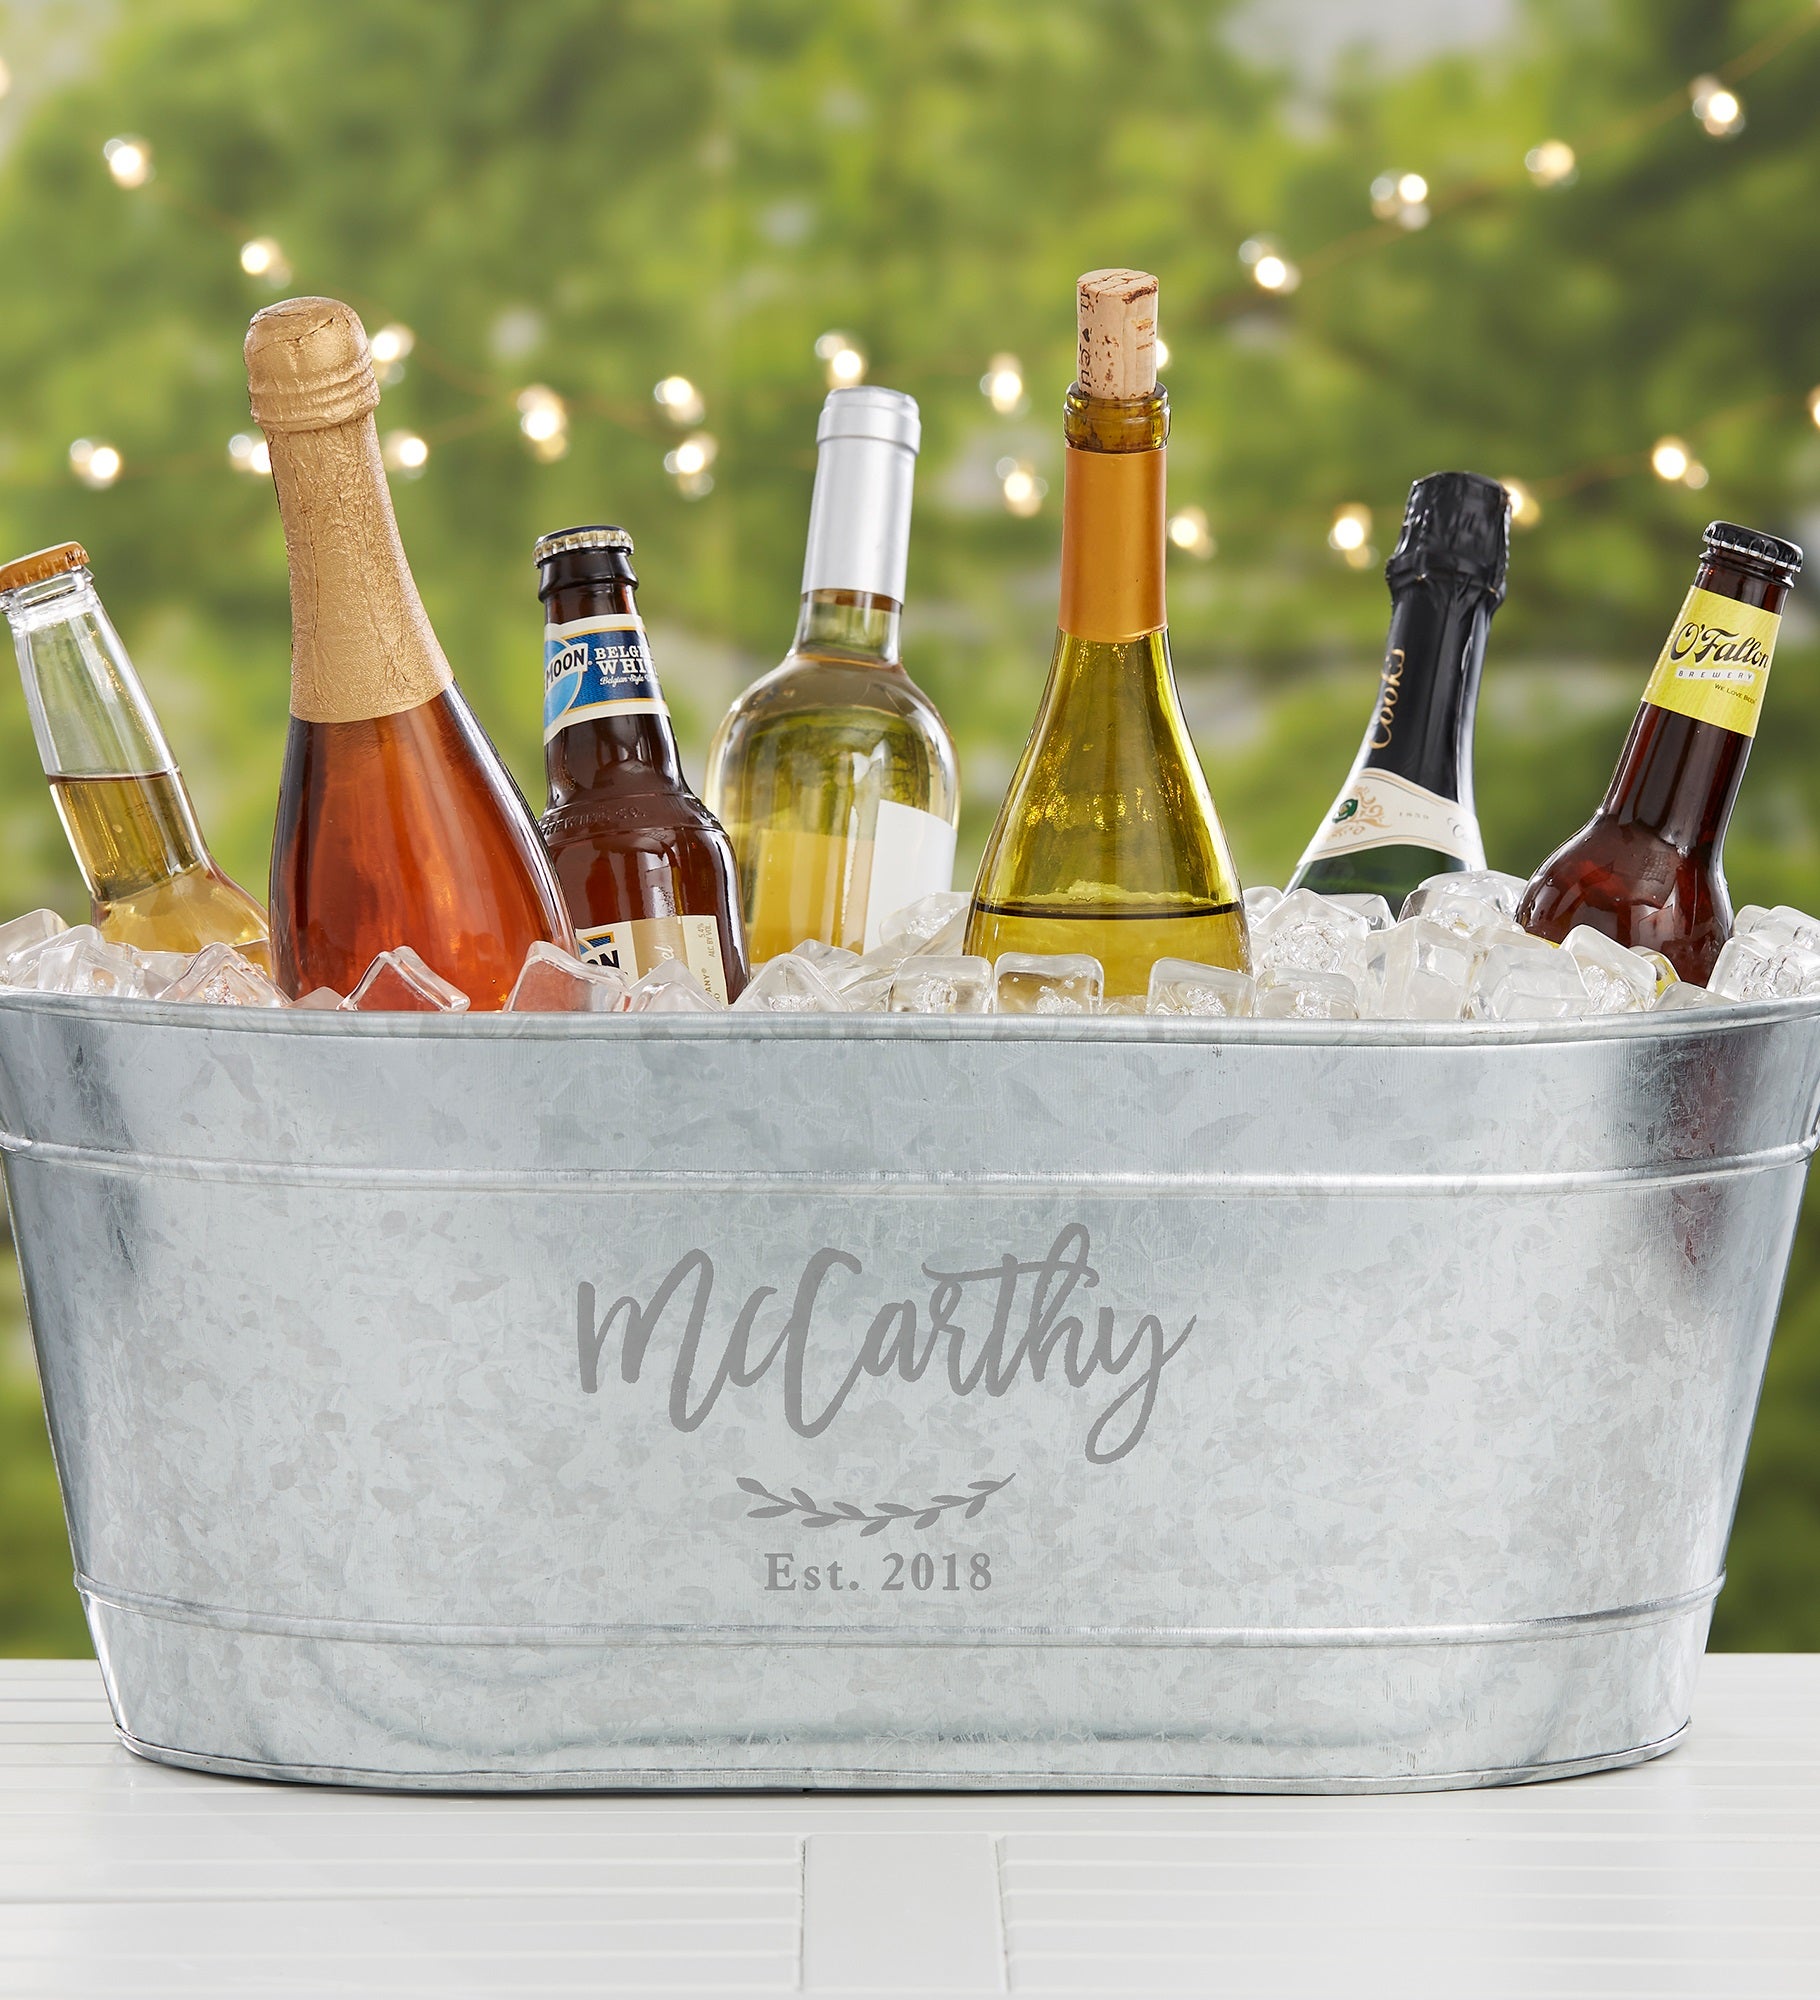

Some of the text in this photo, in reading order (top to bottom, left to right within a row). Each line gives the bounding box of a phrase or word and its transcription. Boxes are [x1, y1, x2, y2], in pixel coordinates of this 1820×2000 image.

[594, 645, 644, 660] BELGI
[1669, 622, 1769, 668] O'Fallon
[546, 648, 585, 690] MOON
[596, 658, 647, 676] WHI
[1678, 670, 1752, 680] BREWERY
[1726, 688, 1743, 699] LOVE
[577, 1222, 1197, 1464] McCarthy
[764, 1552, 993, 1591] Est. 2018
